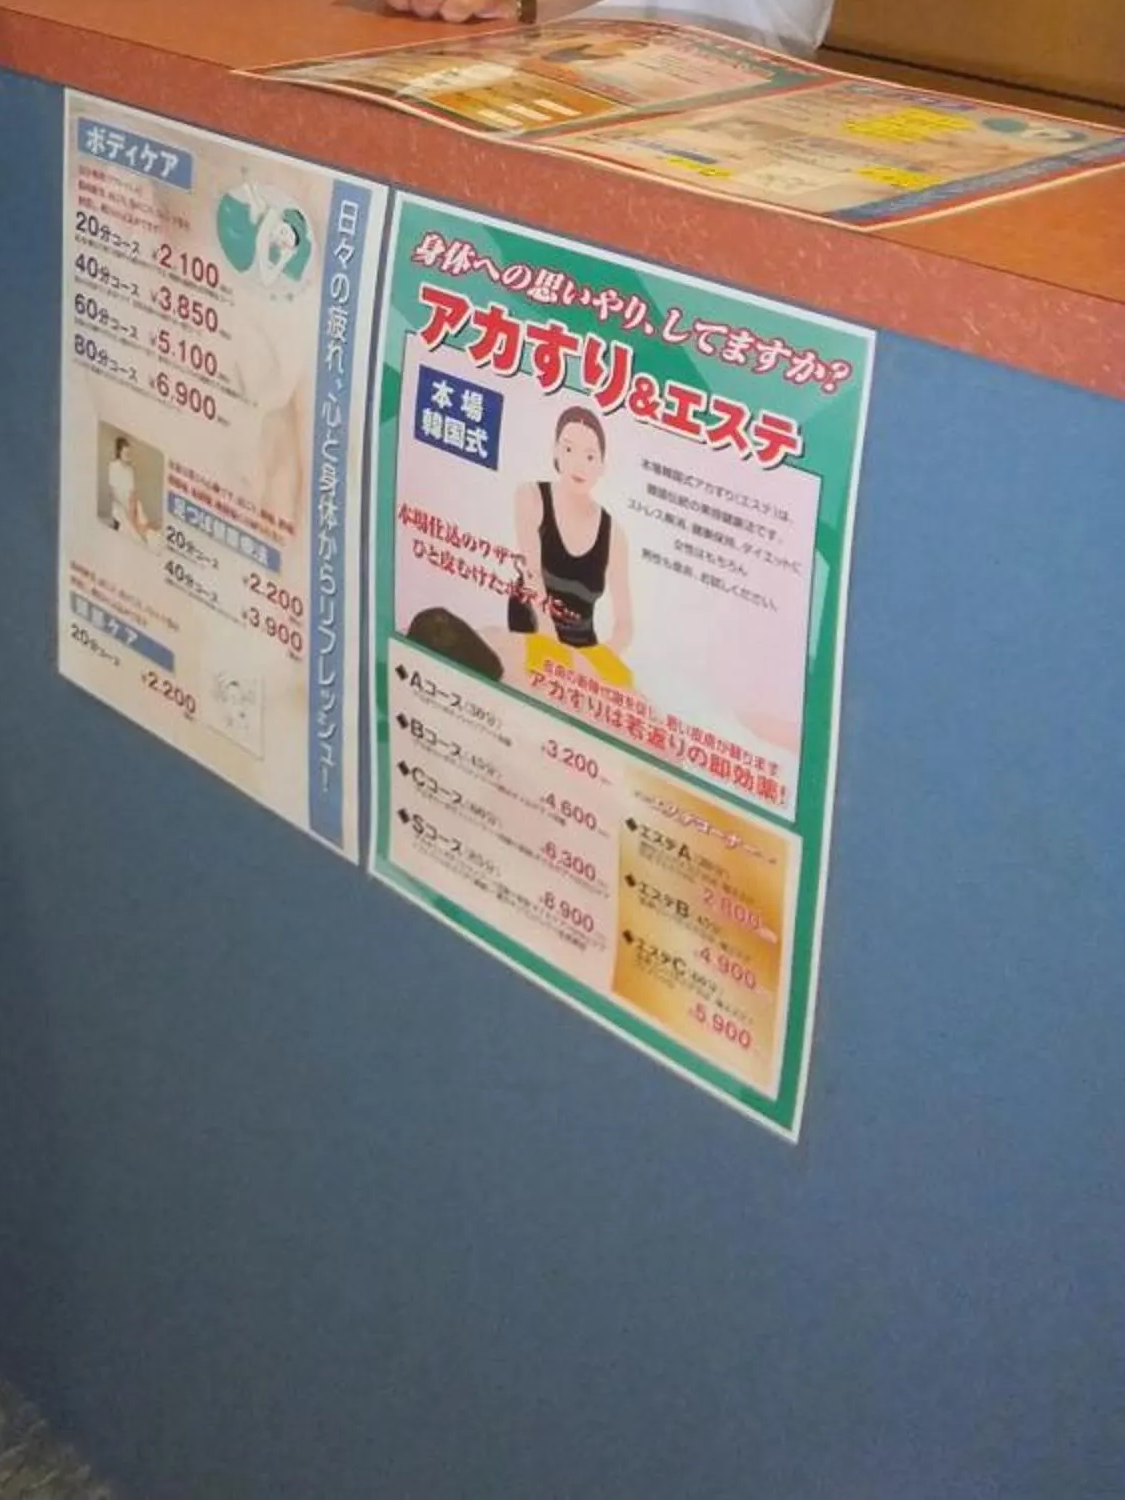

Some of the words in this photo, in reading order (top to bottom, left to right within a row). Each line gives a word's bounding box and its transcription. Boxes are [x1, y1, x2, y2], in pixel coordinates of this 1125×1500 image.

[85, 126, 178, 179] ボディケア
[418, 281, 803, 469] アカすり&エステ
[431, 378, 484, 422] 本場
[420, 408, 489, 459] 韓国式
